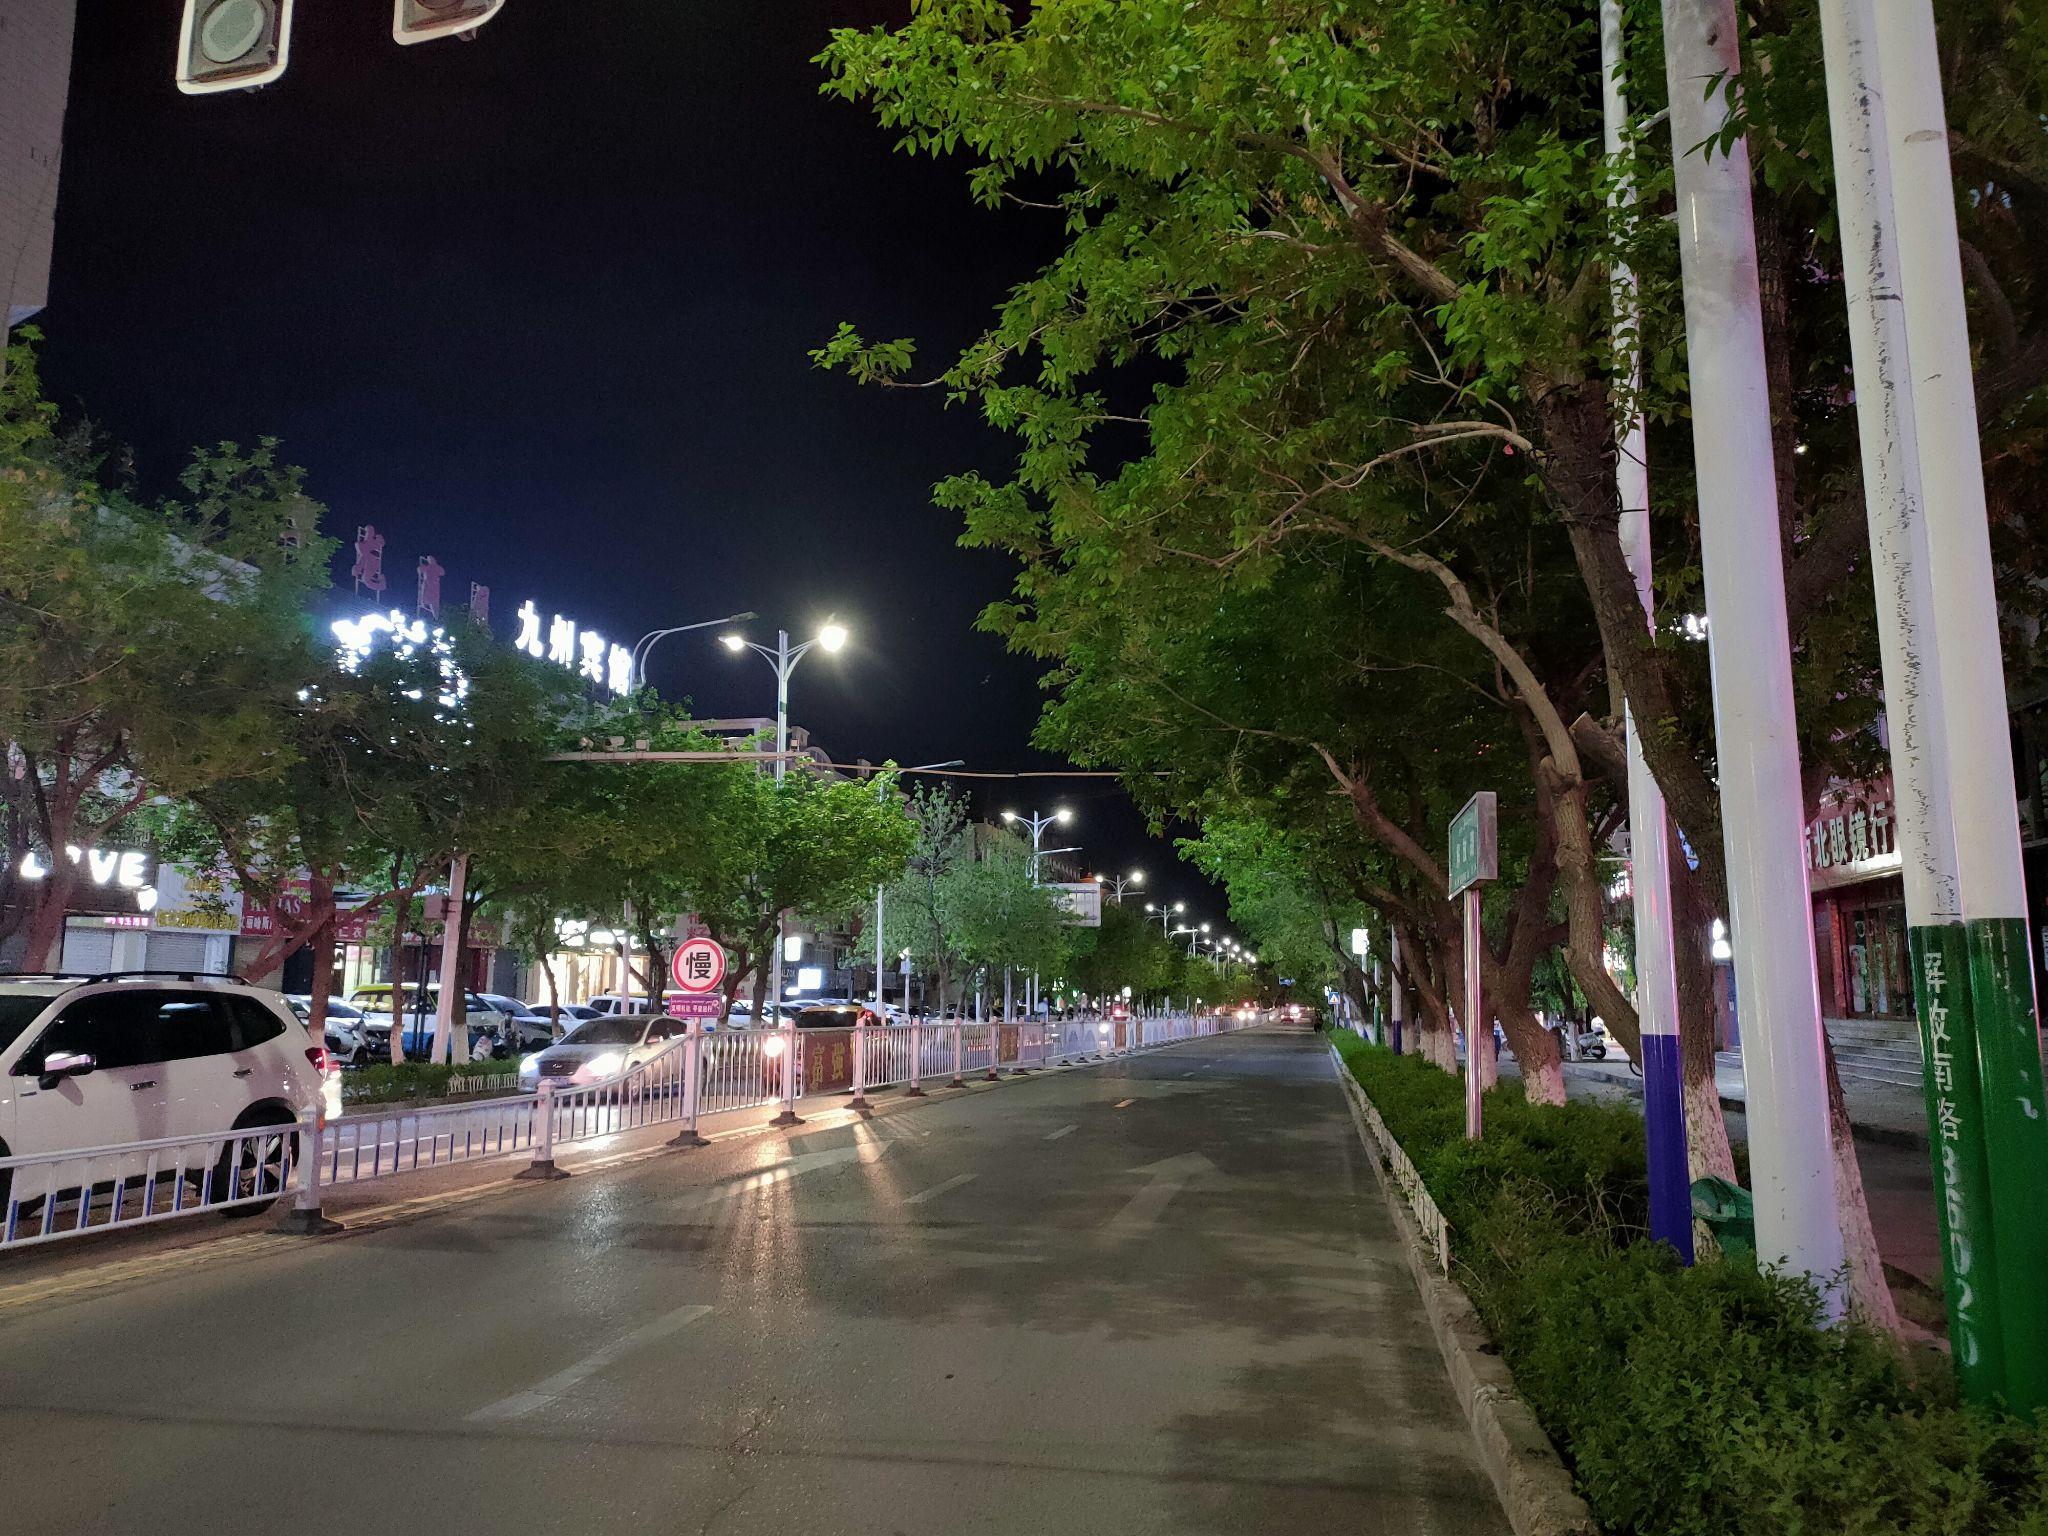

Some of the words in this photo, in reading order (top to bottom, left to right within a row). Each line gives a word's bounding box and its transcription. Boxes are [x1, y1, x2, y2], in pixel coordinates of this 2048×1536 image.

[1805, 801, 1889, 871] 北眼镜行
[685, 951, 712, 980] 慢
